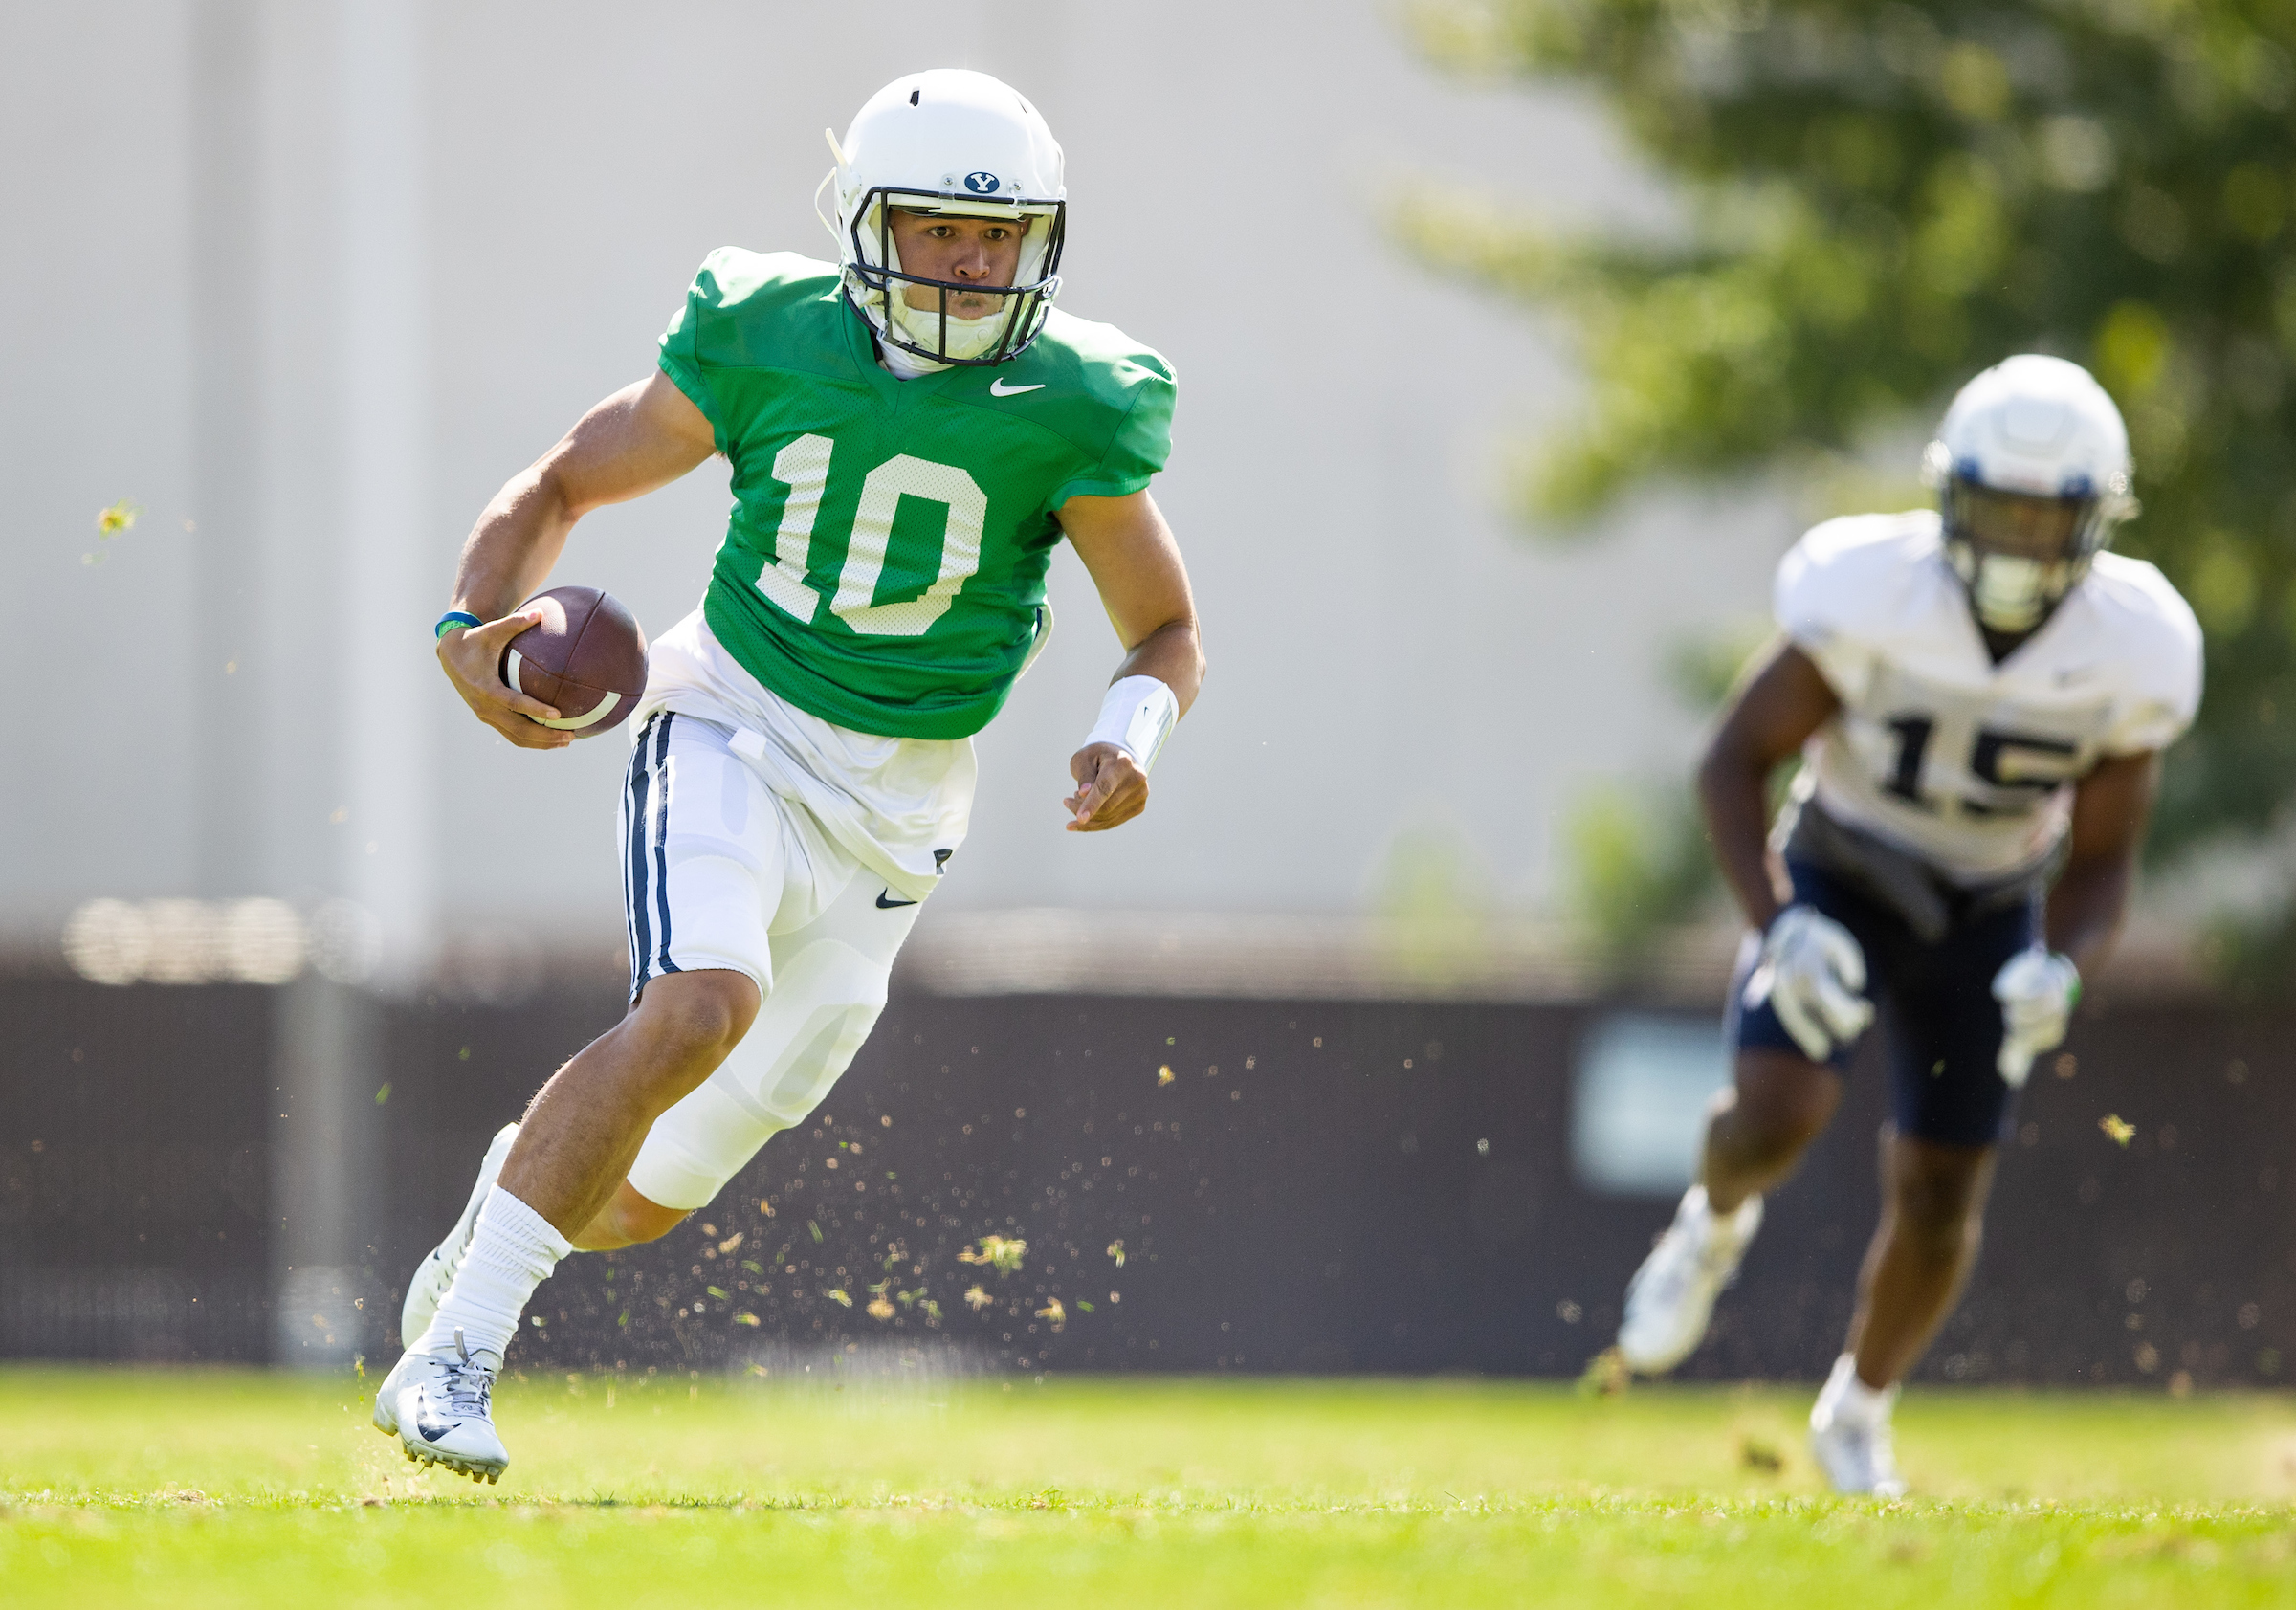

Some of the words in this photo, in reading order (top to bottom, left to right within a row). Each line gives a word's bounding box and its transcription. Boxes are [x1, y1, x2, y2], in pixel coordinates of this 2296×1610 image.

[970, 173, 995, 191] Y
[754, 432, 988, 636] 10
[1881, 713, 2076, 819] 15
